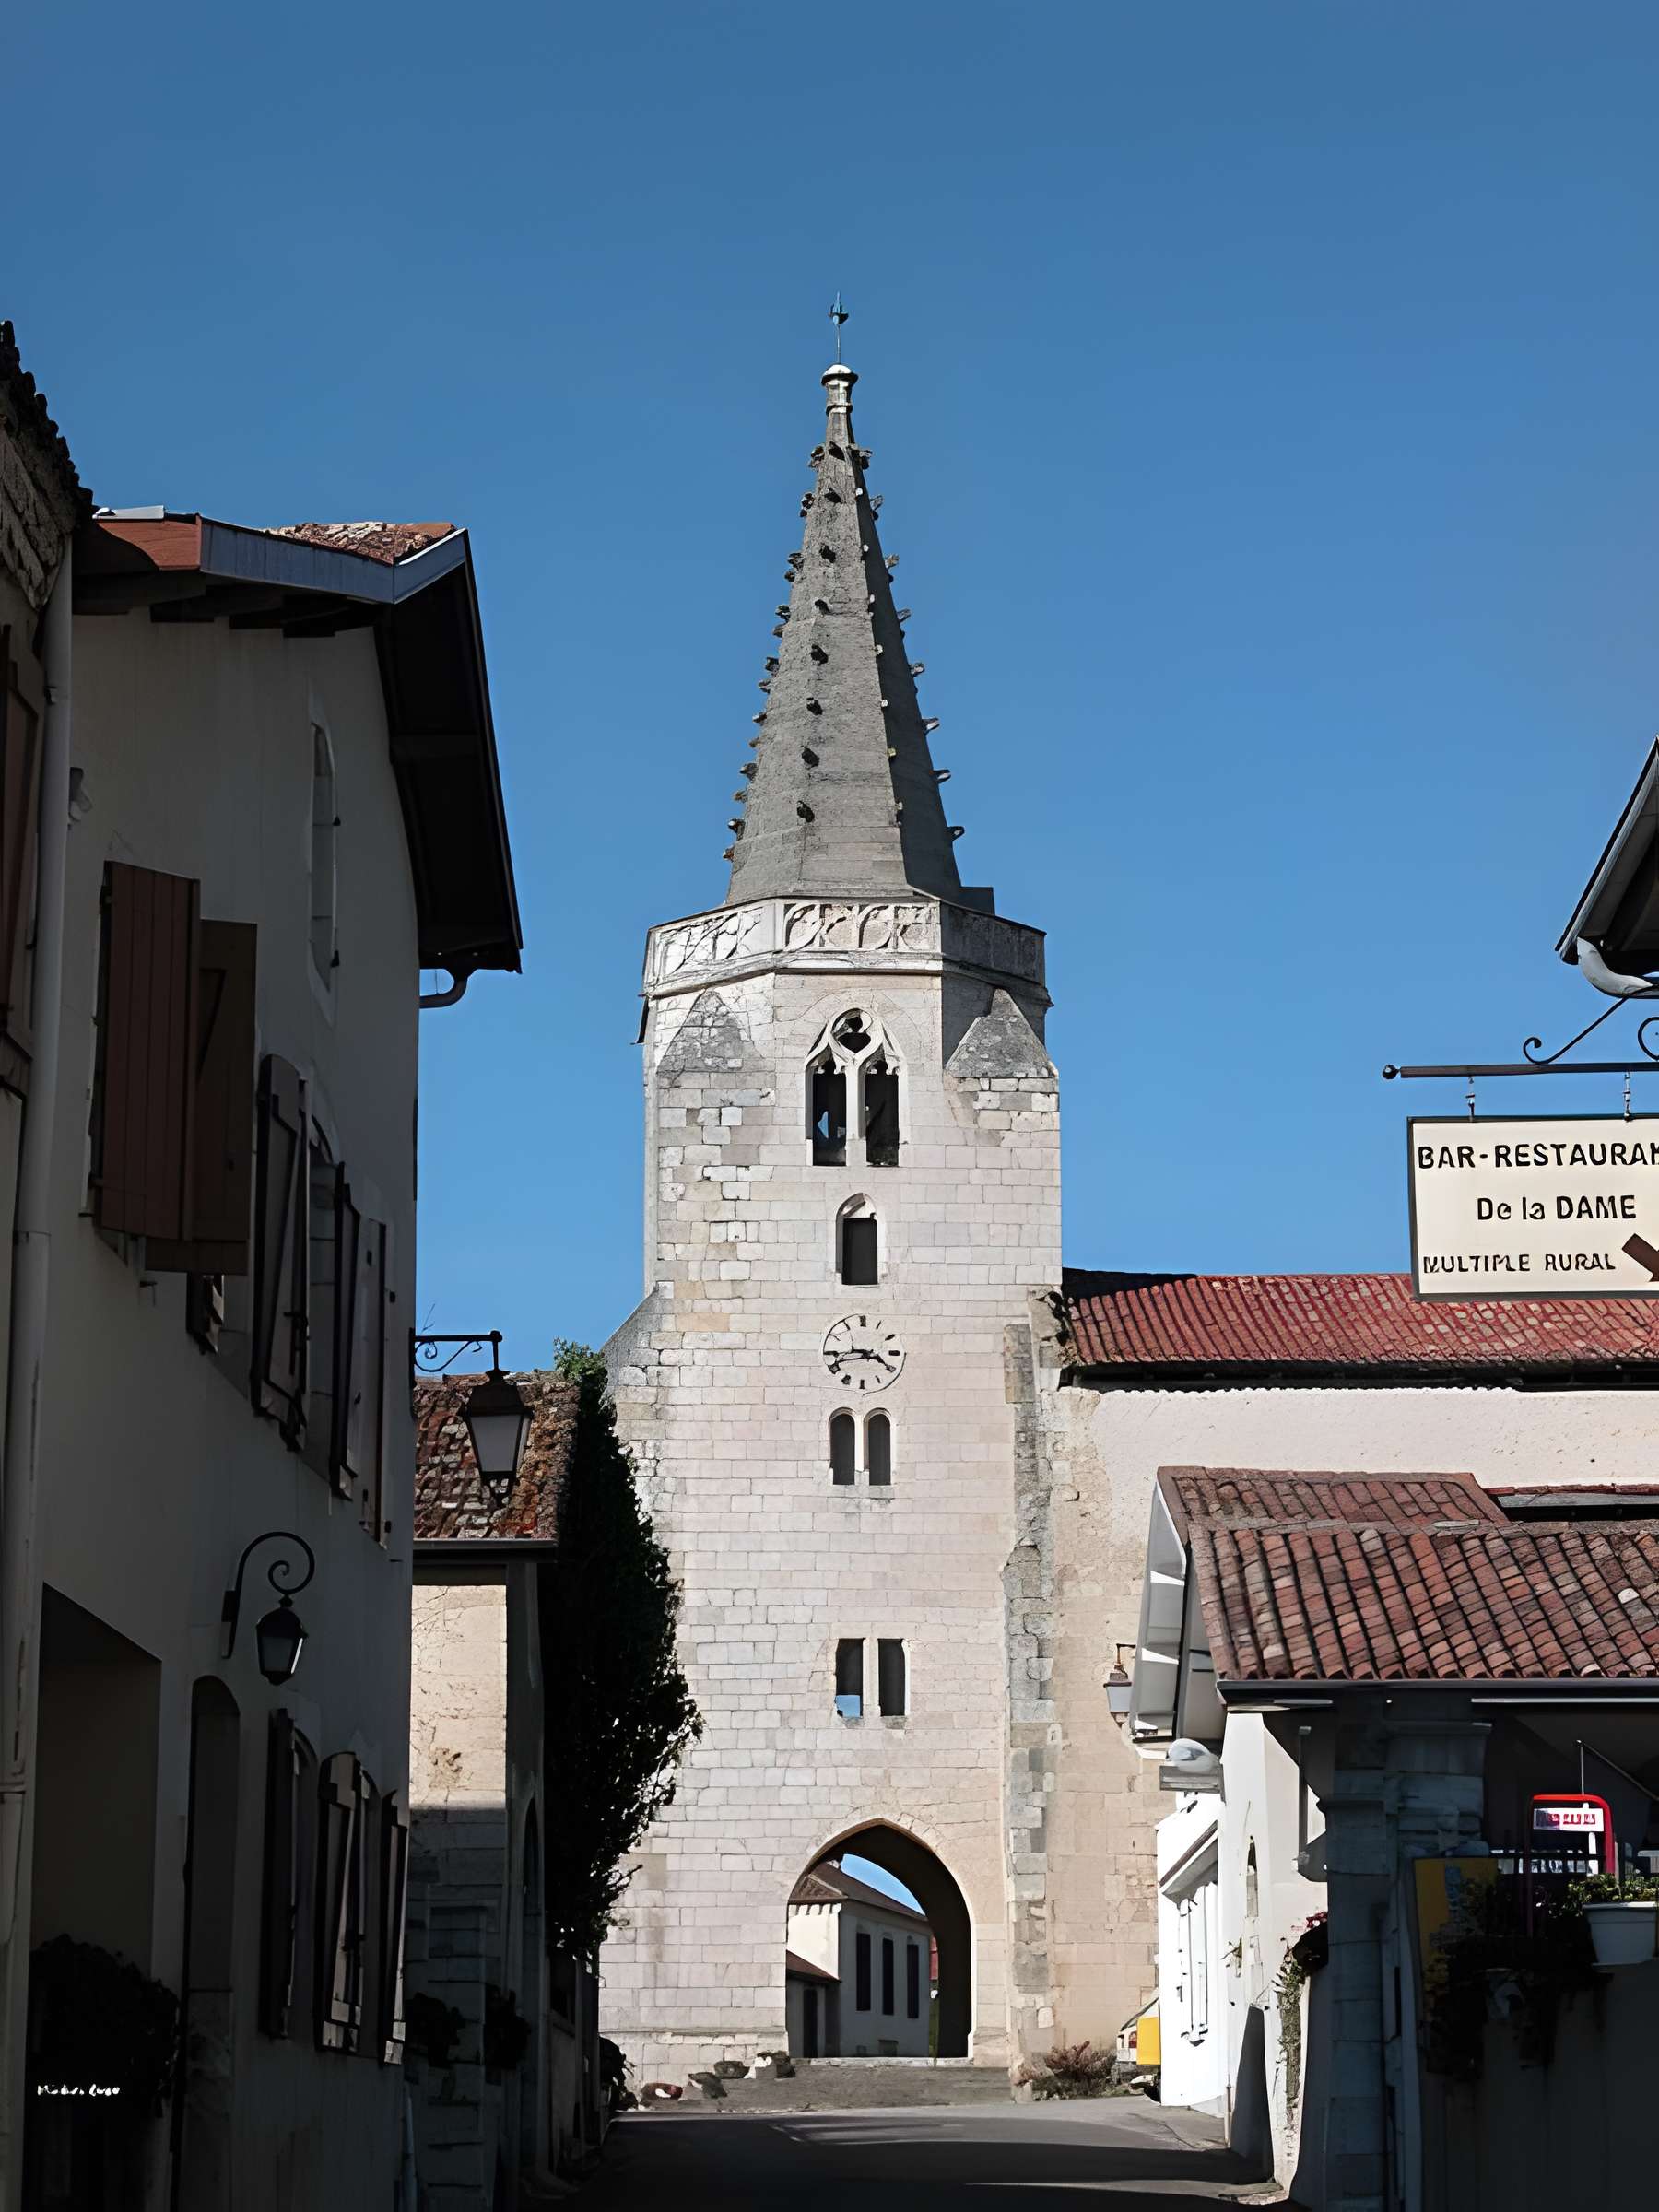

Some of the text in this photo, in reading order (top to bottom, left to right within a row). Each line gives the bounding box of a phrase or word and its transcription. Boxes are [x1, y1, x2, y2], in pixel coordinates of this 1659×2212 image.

[1477, 1195, 1637, 1220] De la DAME
[1423, 1253, 1616, 1273] MULTIPLE RURAL
